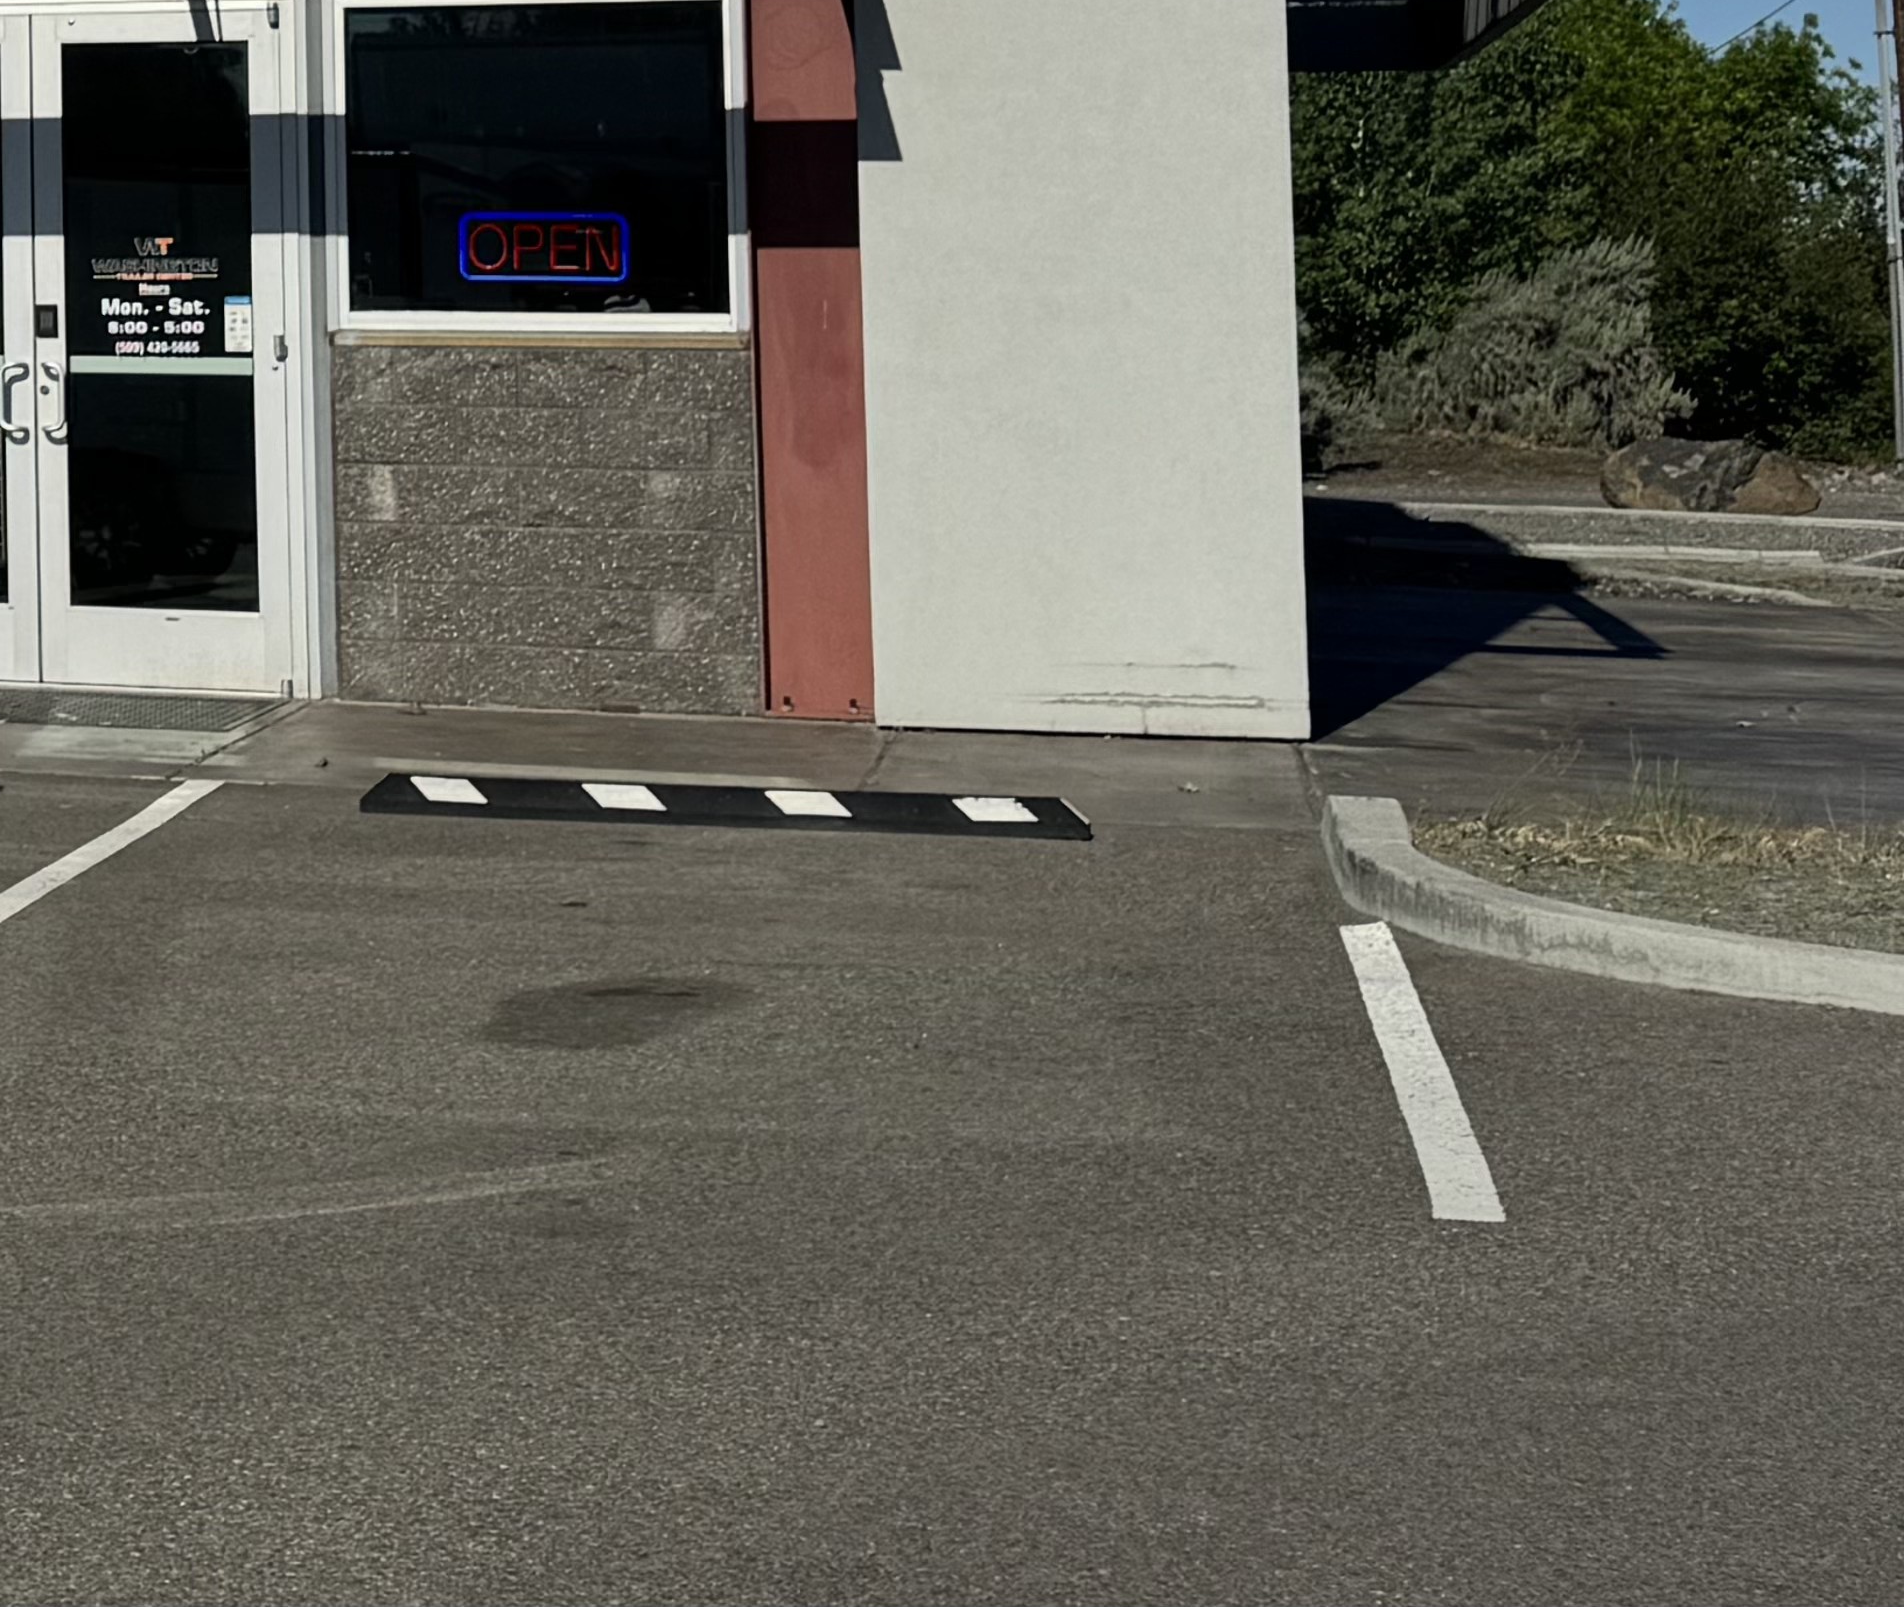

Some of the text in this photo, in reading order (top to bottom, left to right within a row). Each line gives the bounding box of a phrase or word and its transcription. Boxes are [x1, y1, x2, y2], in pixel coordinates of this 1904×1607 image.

[469, 222, 620, 272] OPEN
[101, 298, 149, 316] Mon.
[168, 297, 211, 316] Sat.
[163, 320, 205, 334] 5:00
